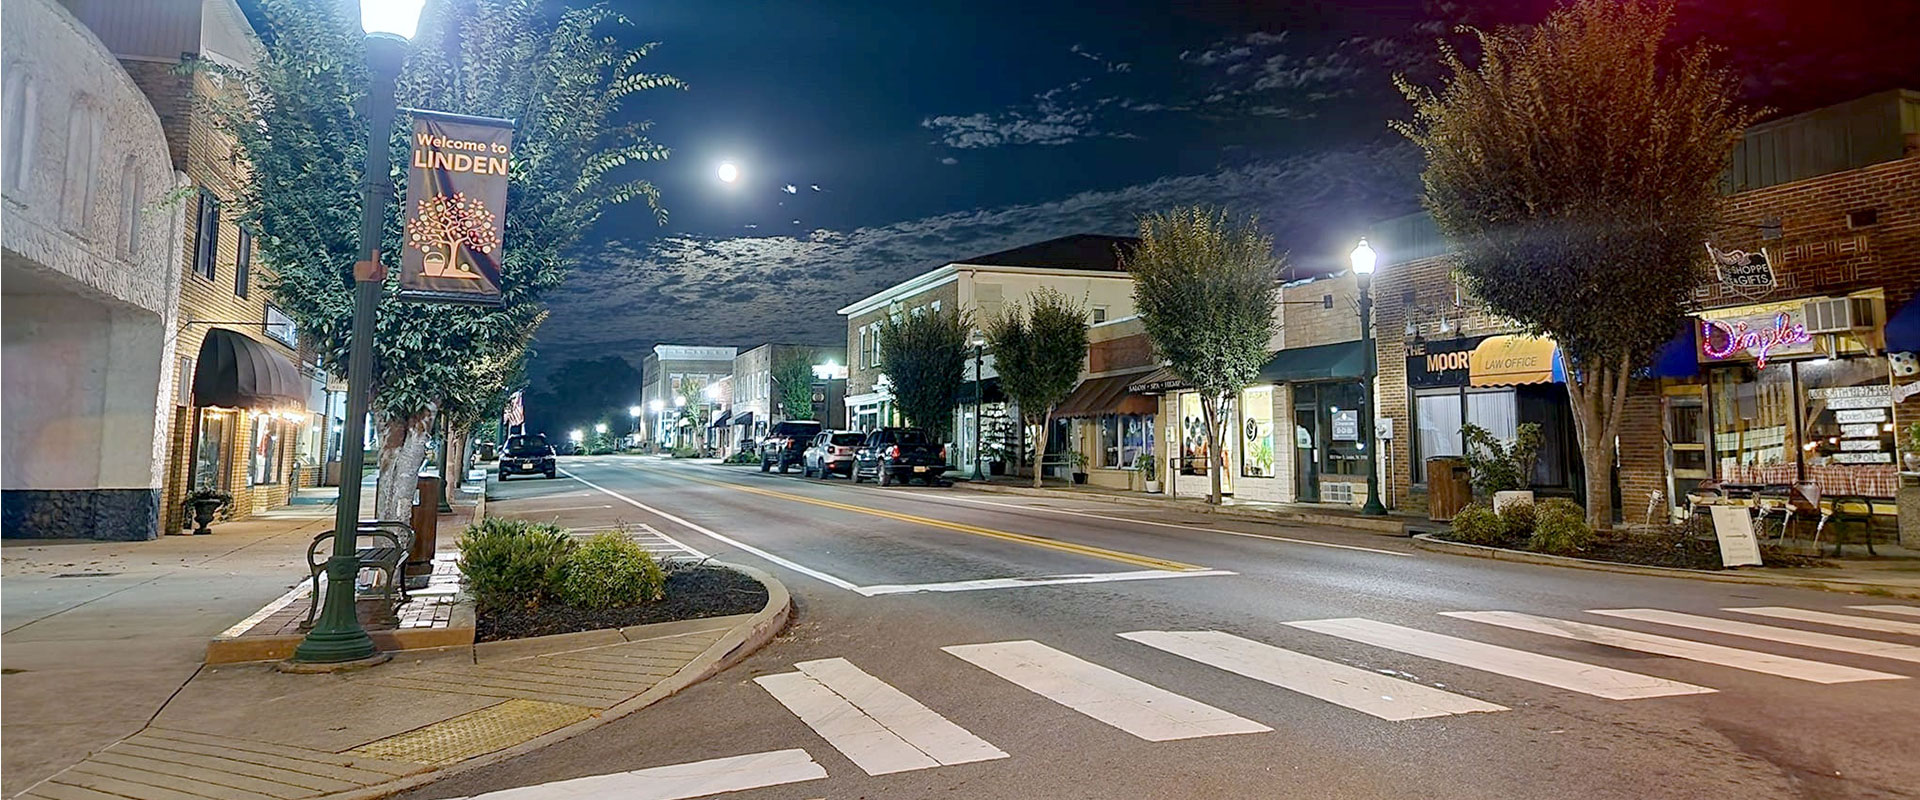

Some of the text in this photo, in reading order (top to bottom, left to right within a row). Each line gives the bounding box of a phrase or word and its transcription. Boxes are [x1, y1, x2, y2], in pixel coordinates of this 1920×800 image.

[416, 133, 508, 155] Welcome to
[414, 150, 508, 176] LINDEN
[1738, 274, 1769, 285] GIFTS
[1404, 344, 1426, 356] THE
[1485, 356, 1537, 370] LAW OFFICE
[1128, 383, 1146, 392] SALON
